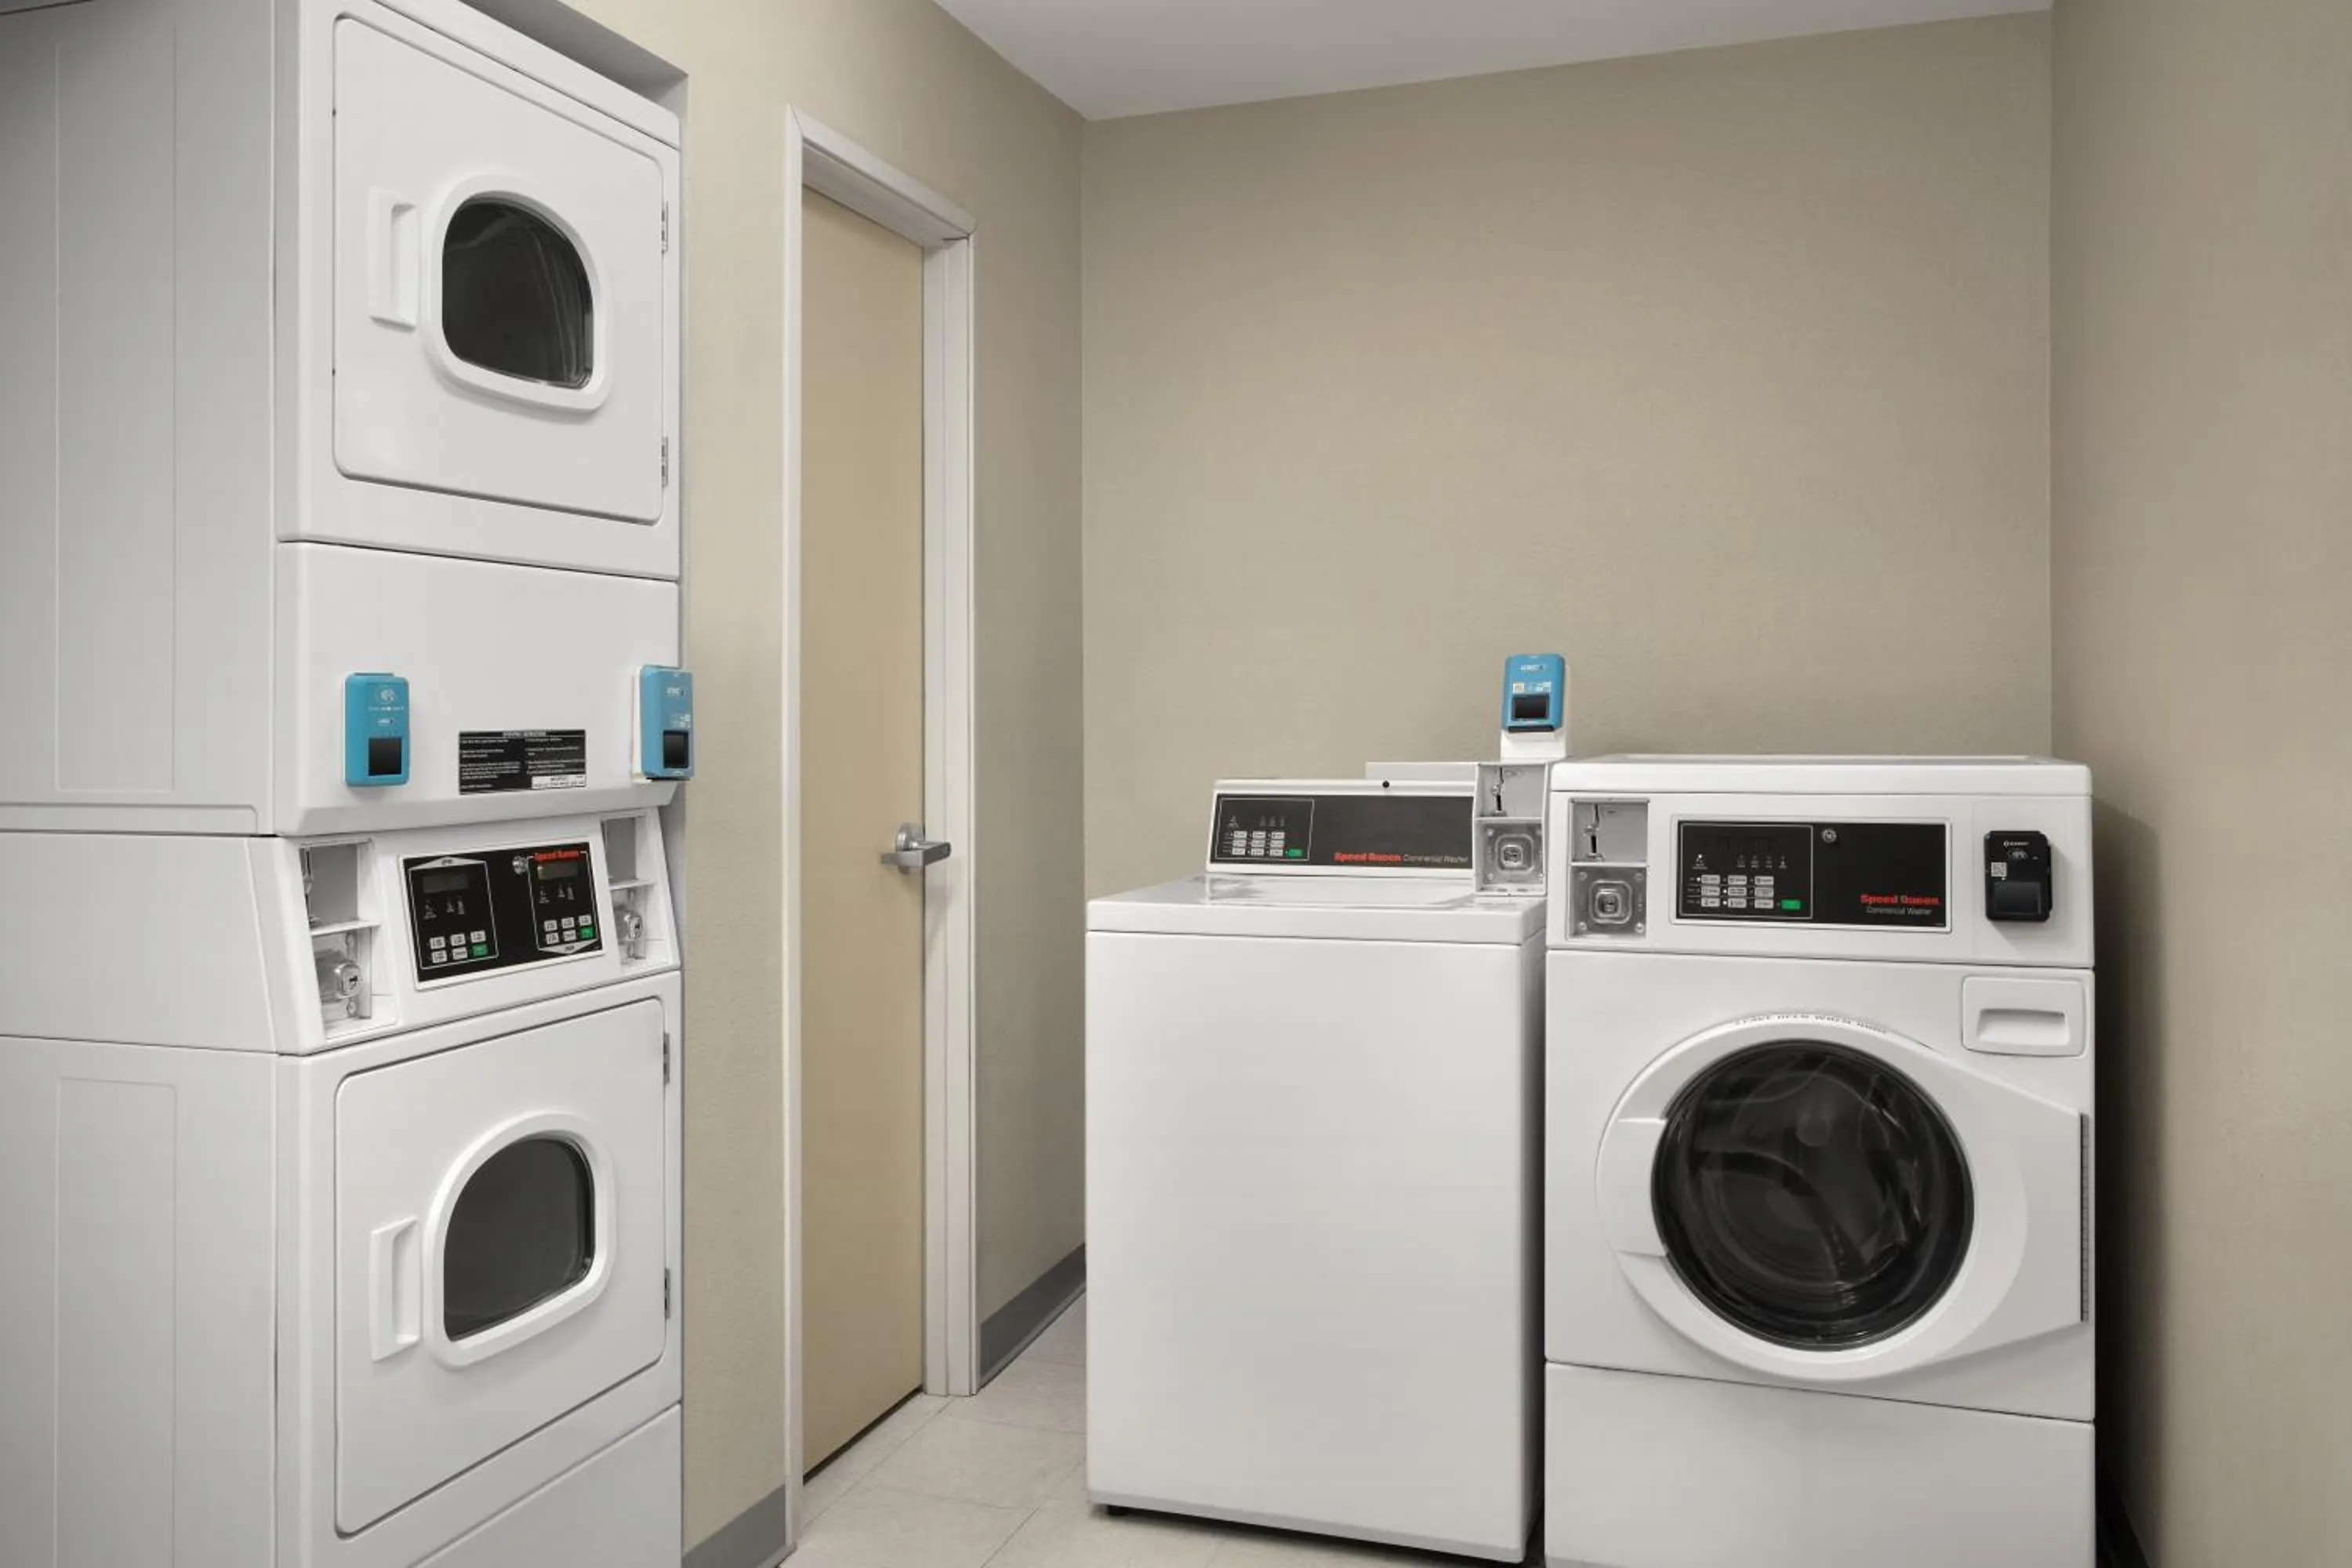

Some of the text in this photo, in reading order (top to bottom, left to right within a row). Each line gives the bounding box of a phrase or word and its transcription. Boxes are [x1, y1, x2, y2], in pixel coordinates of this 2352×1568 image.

[1334, 852, 1367, 862] Speed
[1368, 852, 1403, 862] Queen
[1860, 895, 1940, 905] Speed Queen
